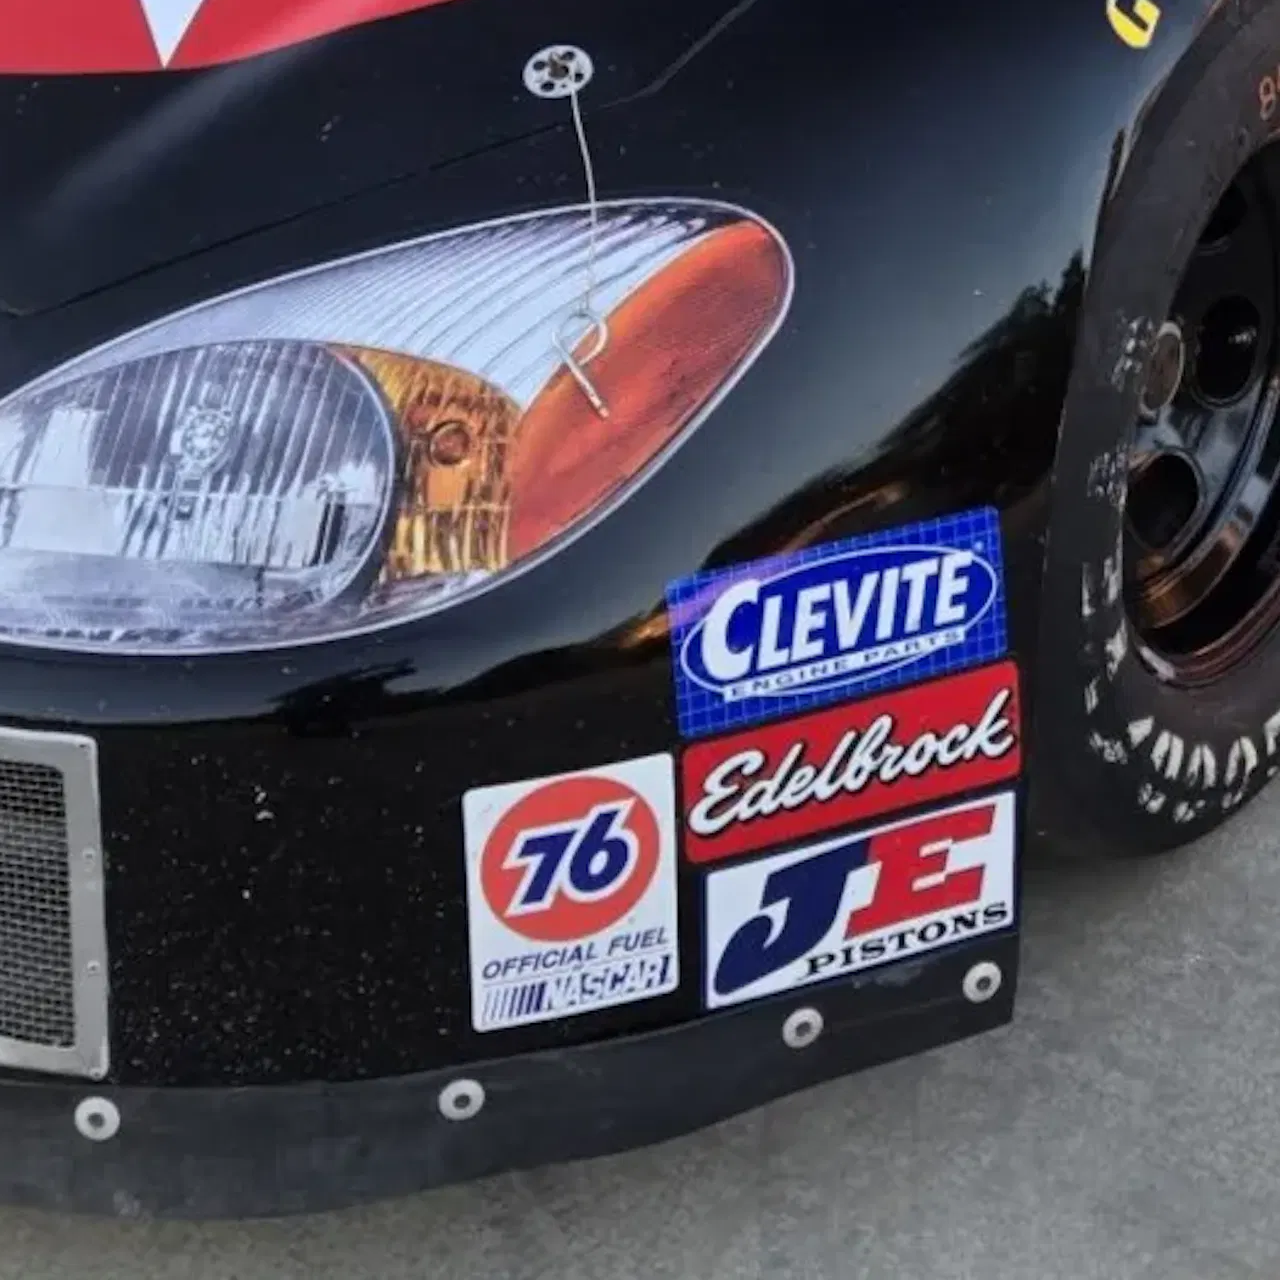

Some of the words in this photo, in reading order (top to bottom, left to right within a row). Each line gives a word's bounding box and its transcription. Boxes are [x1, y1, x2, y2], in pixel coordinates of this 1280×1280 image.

[701, 551, 974, 683] CLEVITE
[728, 658, 852, 699] ENGINE
[862, 629, 964, 666] PARTS
[687, 689, 1016, 836] Edelbrock
[504, 798, 636, 918] 76
[714, 804, 999, 997] JE
[481, 942, 600, 980] OFFICIAL
[607, 926, 670, 957] FUEL
[547, 954, 671, 1011] NASCAR
[806, 902, 1009, 978] PISTONS
